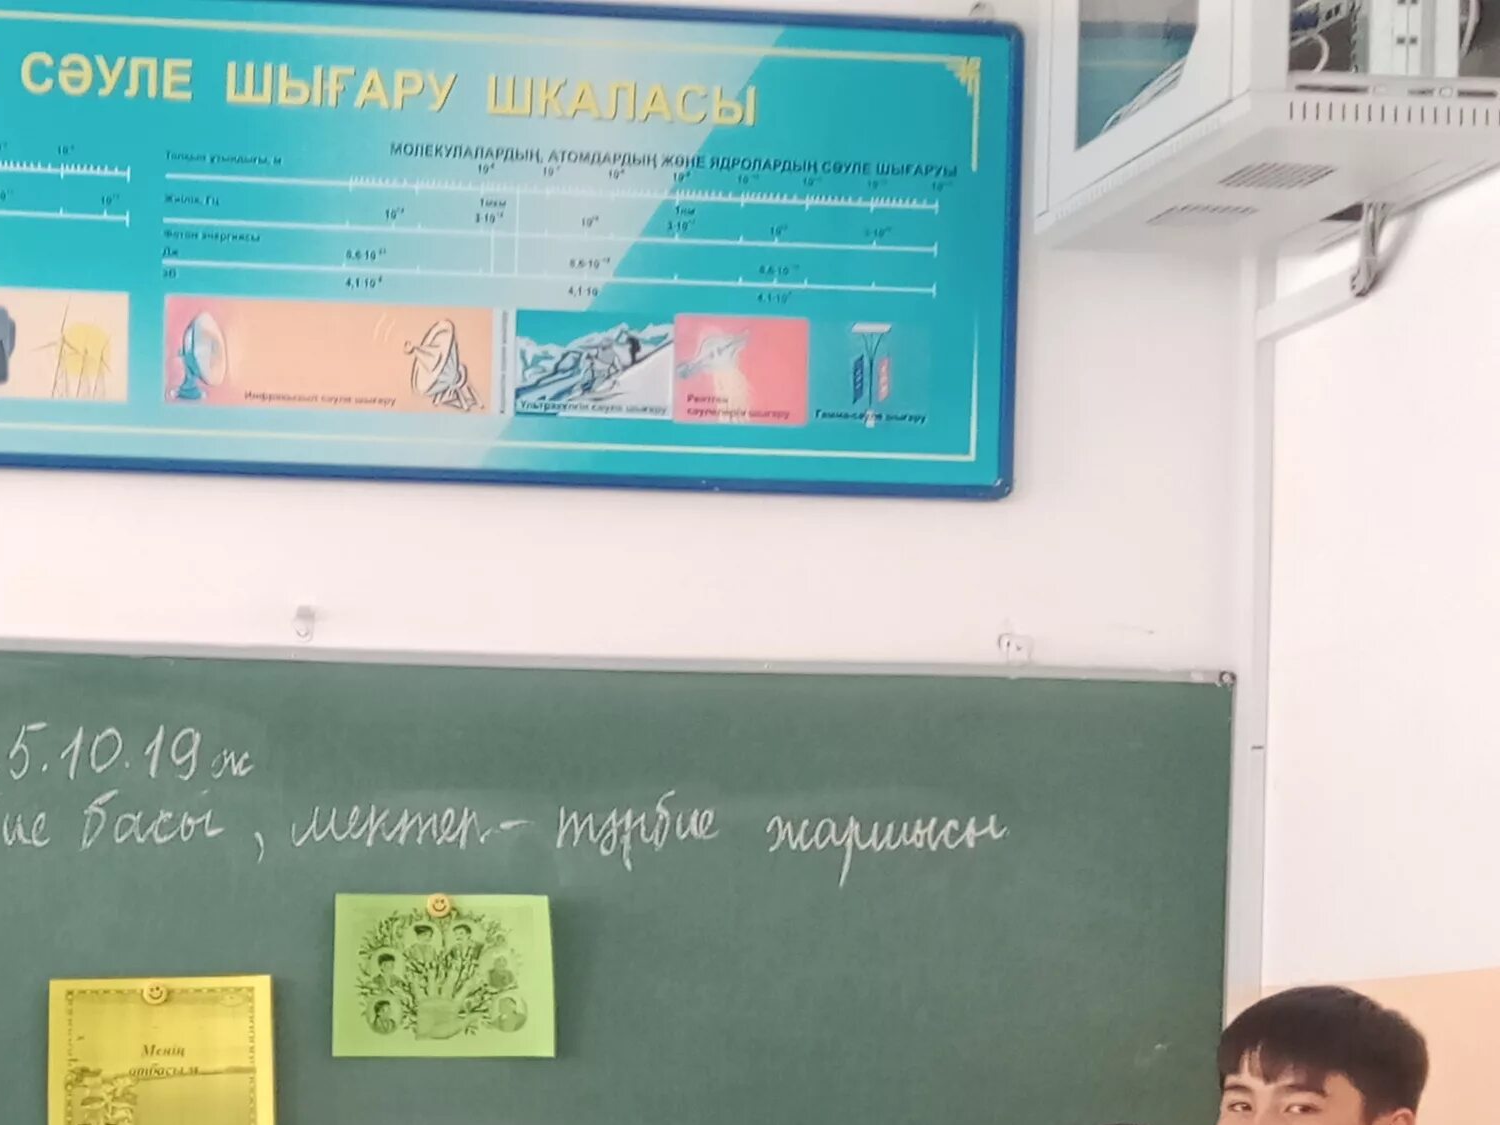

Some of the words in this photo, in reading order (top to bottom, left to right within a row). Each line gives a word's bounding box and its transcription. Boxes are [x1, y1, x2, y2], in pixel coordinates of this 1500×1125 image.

[20, 51, 194, 101] СӘУЛЕ
[225, 60, 458, 112] ШЫҒАРУ
[486, 73, 757, 126] ШКАЛАСЫ
